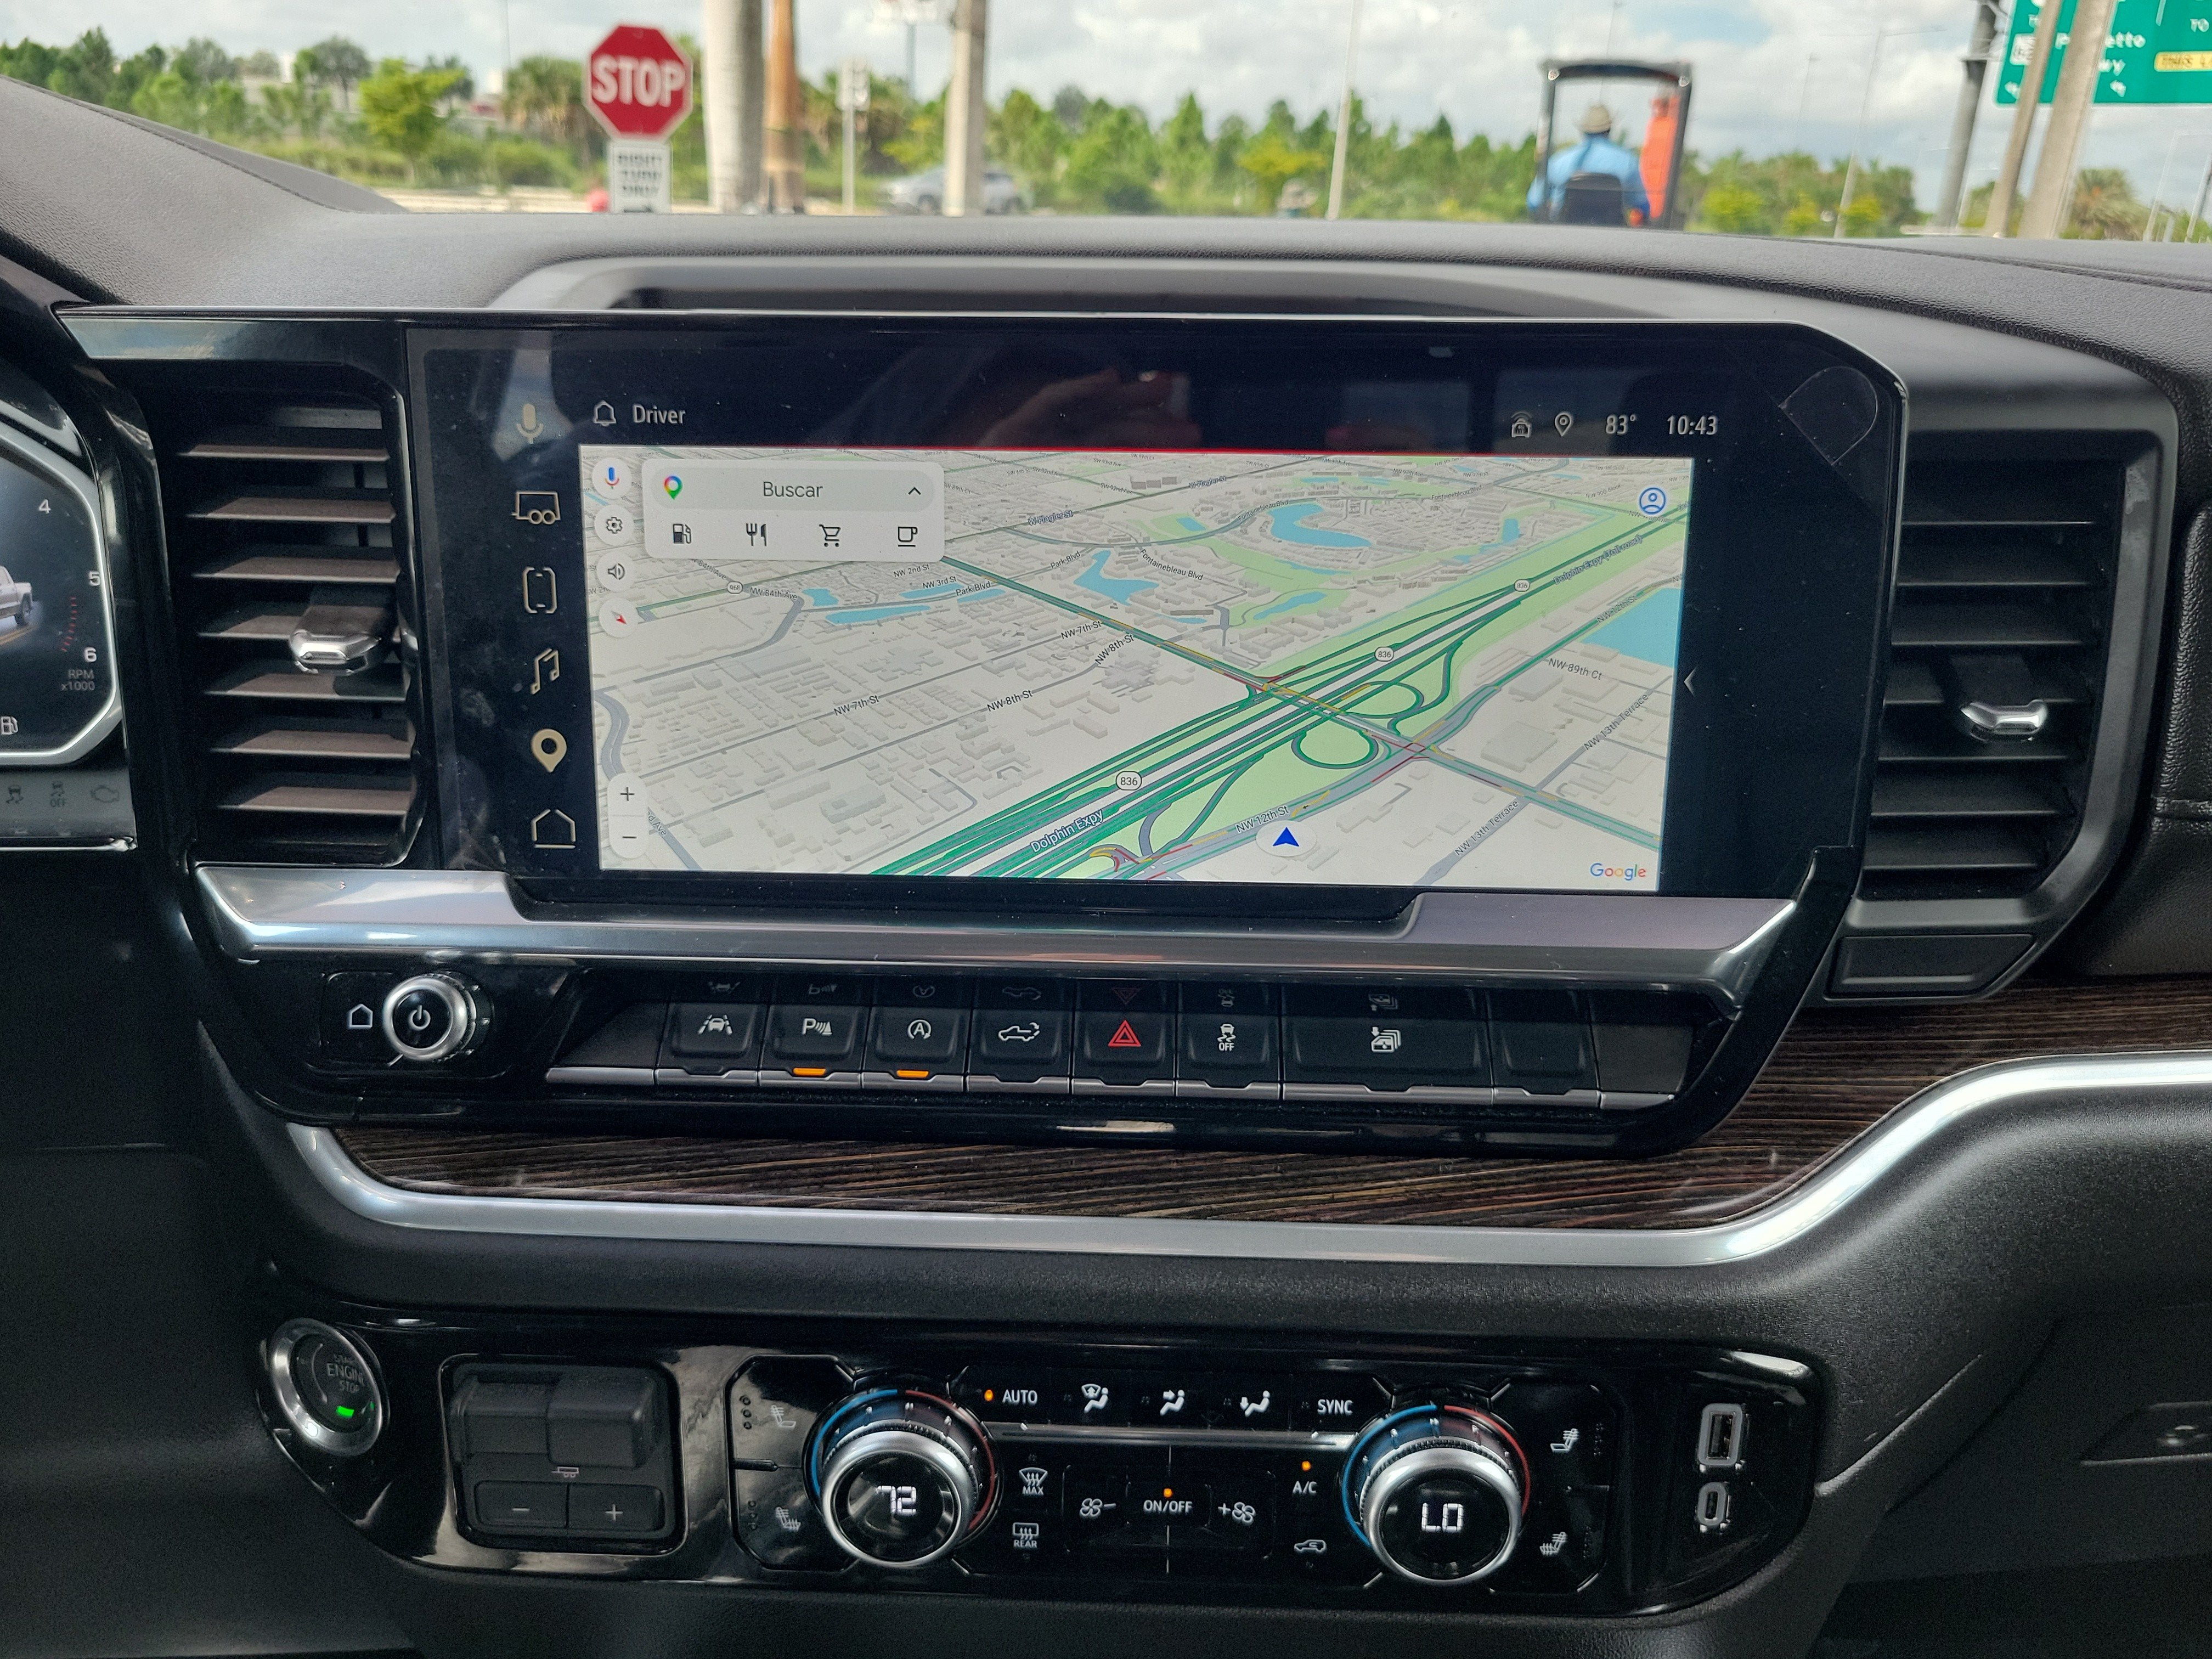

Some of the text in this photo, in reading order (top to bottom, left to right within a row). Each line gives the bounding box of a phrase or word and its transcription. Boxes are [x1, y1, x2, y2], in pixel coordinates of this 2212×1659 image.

[592, 54, 685, 108] STOP
[632, 405, 686, 425] Driver
[1605, 414, 1637, 435] 83°
[1667, 415, 1718, 436] 10:43
[763, 481, 823, 499] Buscar
[38, 499, 51, 514] 4
[1028, 510, 1074, 526] W Flagler St
[1050, 551, 1081, 569] Park Blvd
[1141, 549, 1204, 581] Fontainebleau Blvd
[88, 571, 100, 586] 5
[713, 569, 726, 580] Ave
[894, 563, 930, 578] NW 2nd St
[1554, 563, 1584, 585] Dolphin
[1583, 555, 1604, 570] Expy
[922, 581, 936, 589] NW
[936, 578, 949, 586] 3rd
[956, 581, 992, 596] Park Blvd
[749, 586, 798, 600] NW 84th Ave
[1596, 595, 1637, 624] NW 12th St
[1060, 620, 1103, 640] NW 7th St
[84, 647, 97, 662] 6
[1095, 633, 1135, 665] NW 8th St
[1378, 650, 1391, 658] 836
[68, 669, 94, 680] RPM
[1548, 658, 1602, 680] NW 89th Ct
[61, 680, 95, 692] x1000
[833, 695, 879, 716] NW 7th St
[986, 689, 1033, 713] NW 8th St
[1583, 692, 1649, 752] NW 13th Terrace
[1120, 776, 1138, 787] 836
[1235, 805, 1290, 834] NW 12th St
[1454, 799, 1519, 857] NW 13th Terrace
[1030, 809, 1105, 853] Dolphin Expy
[1590, 862, 1647, 882] Google
[1218, 1042, 1234, 1052] OFF
[1002, 1390, 1038, 1406] AUTO
[1317, 1400, 1353, 1415] SYNC
[1022, 1486, 1044, 1496] MAX
[1293, 1481, 1317, 1496] A/C
[877, 1485, 917, 1516] 72
[1143, 1500, 1193, 1514] ON/OFF
[1014, 1539, 1038, 1549] REAR
